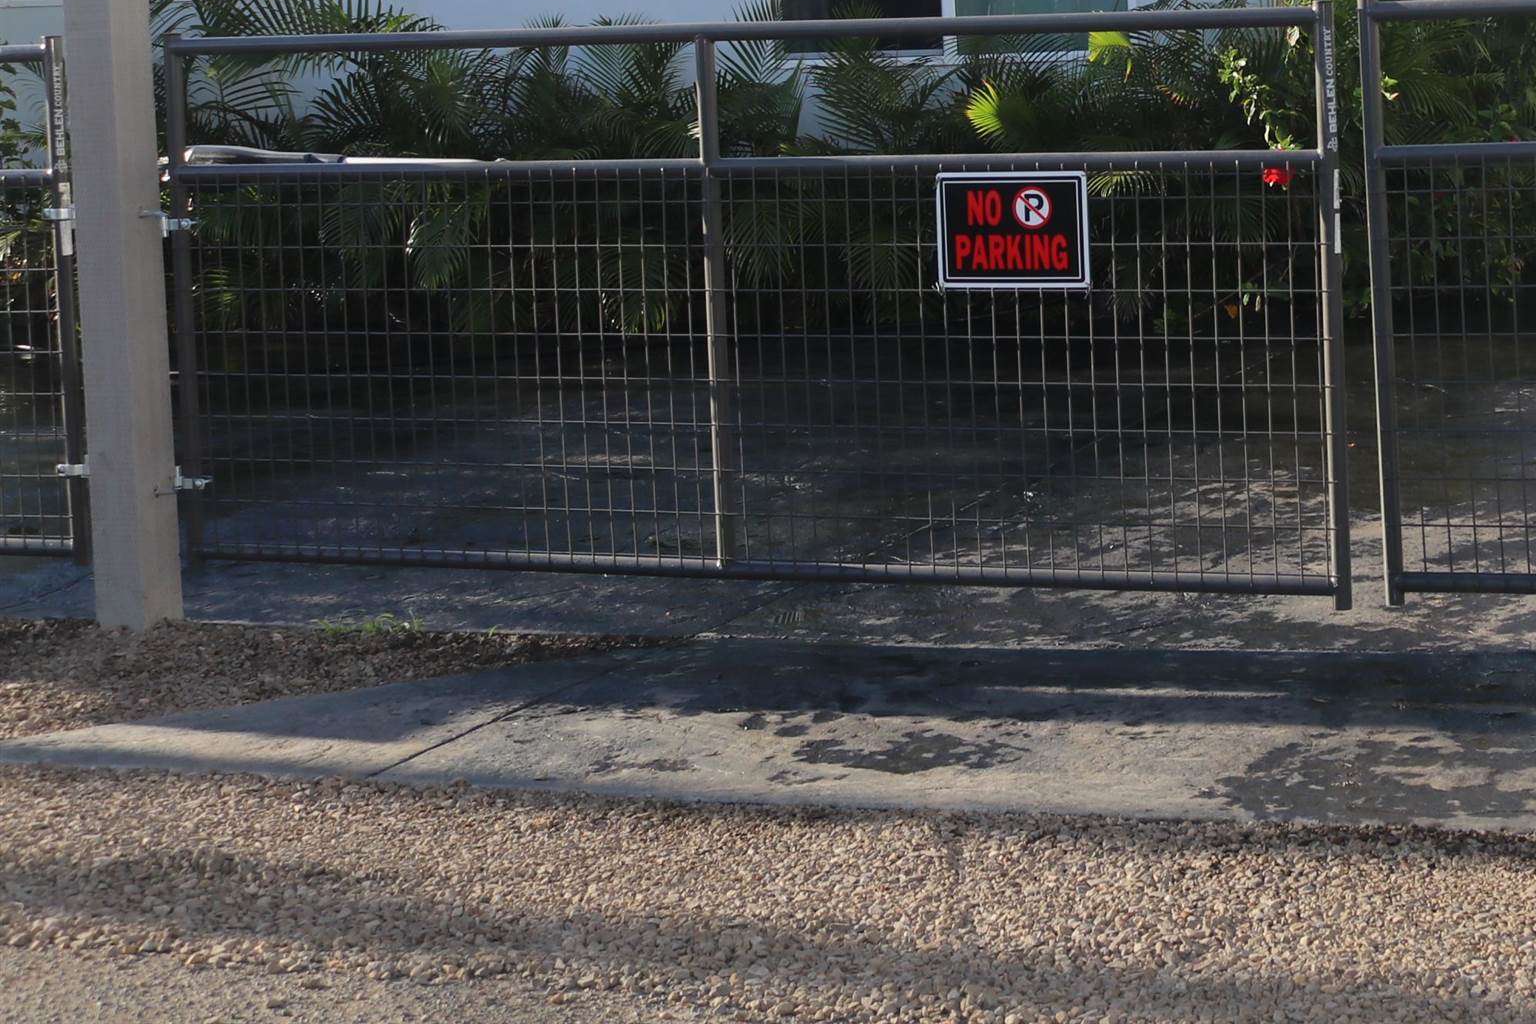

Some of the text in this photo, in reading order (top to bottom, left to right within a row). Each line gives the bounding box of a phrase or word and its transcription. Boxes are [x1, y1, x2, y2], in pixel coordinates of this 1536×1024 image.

[54, 67, 65, 156] BEHLEN COUNTRY
[1323, 28, 1337, 133] BEHLEN COUNTRY
[966, 189, 1003, 227] NO
[954, 234, 1070, 271] PARKING
